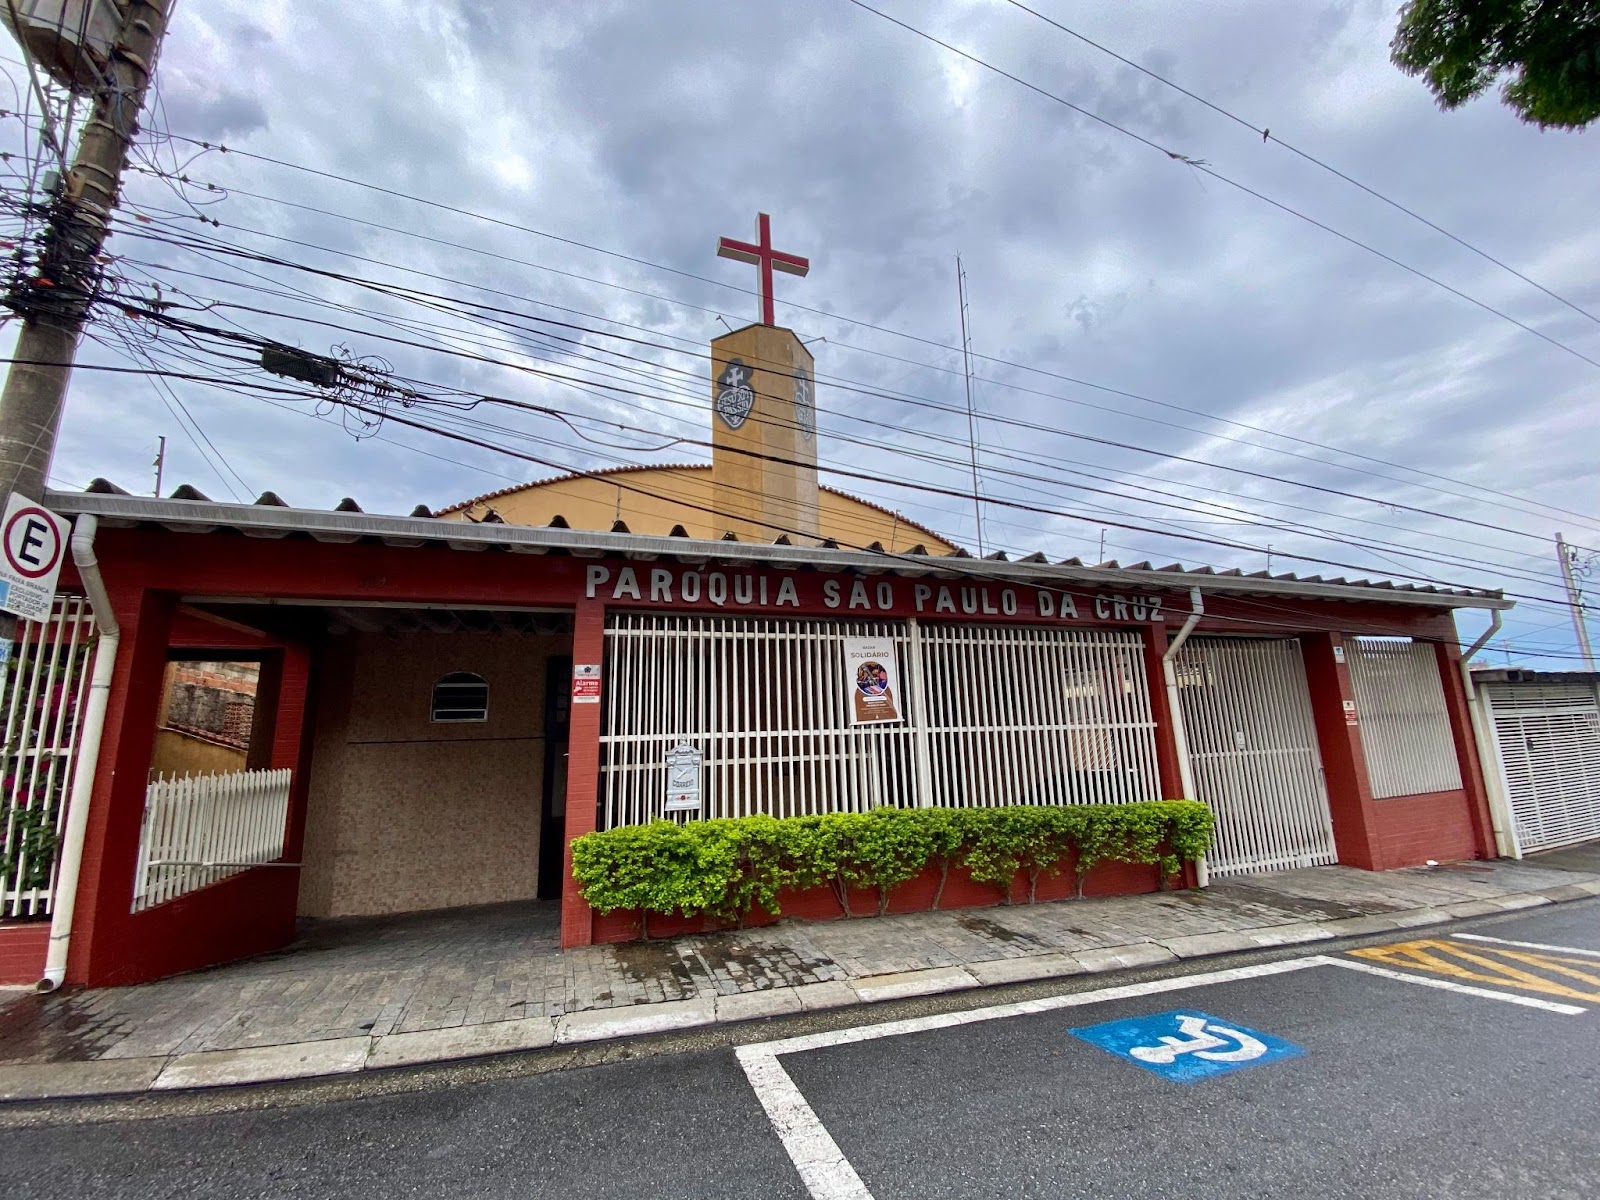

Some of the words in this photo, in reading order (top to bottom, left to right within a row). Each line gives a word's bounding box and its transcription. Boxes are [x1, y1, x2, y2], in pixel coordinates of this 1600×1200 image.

[19, 518, 48, 566] E
[9, 591, 41, 605] PORTADOR
[26, 581, 49, 594] BRANCA
[823, 573, 894, 610] SÃO
[914, 583, 1018, 616] PAULO
[1038, 590, 1079, 619] DA
[1095, 594, 1164, 622] CRUZ
